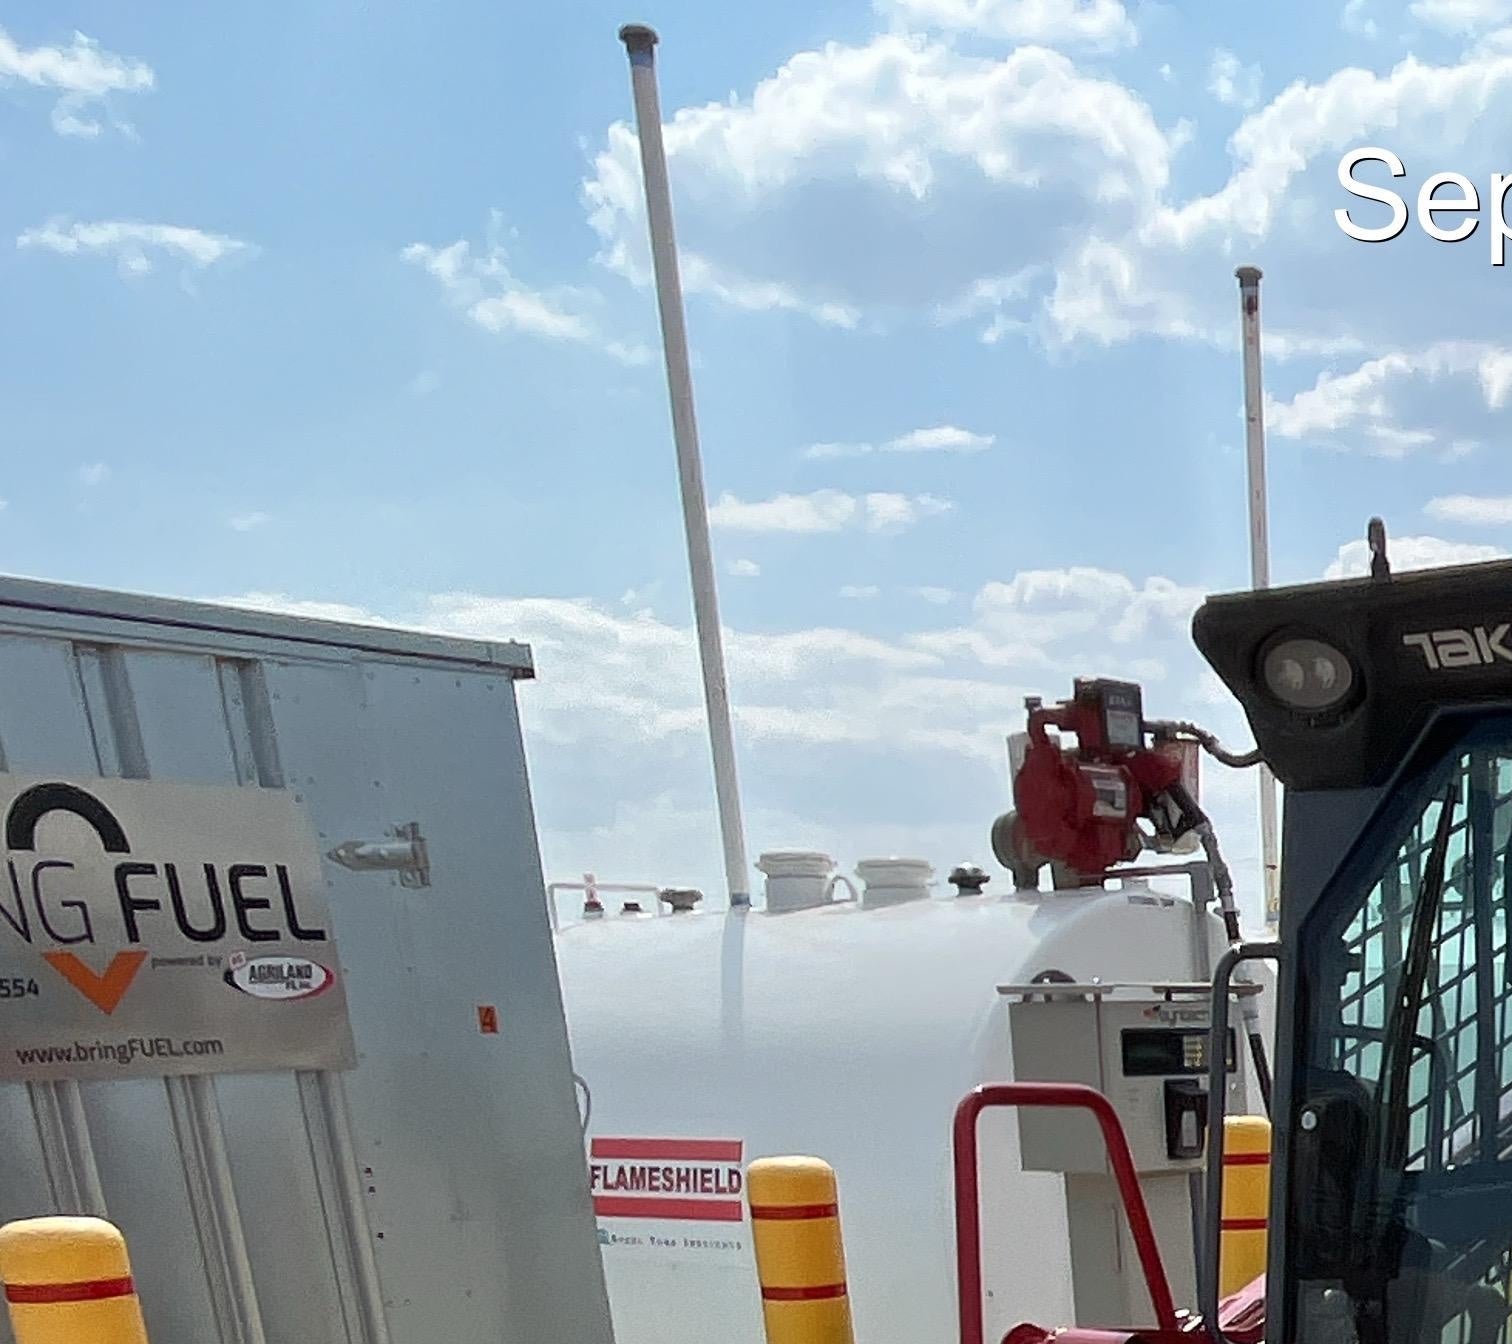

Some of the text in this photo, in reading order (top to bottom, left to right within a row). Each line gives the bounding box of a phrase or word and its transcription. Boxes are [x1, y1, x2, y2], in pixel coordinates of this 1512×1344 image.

[114, 862, 328, 943] FUEL
[15, 1036, 225, 1066] www.bringFUEL.com
[590, 1165, 742, 1195] FLAMESHIELD
